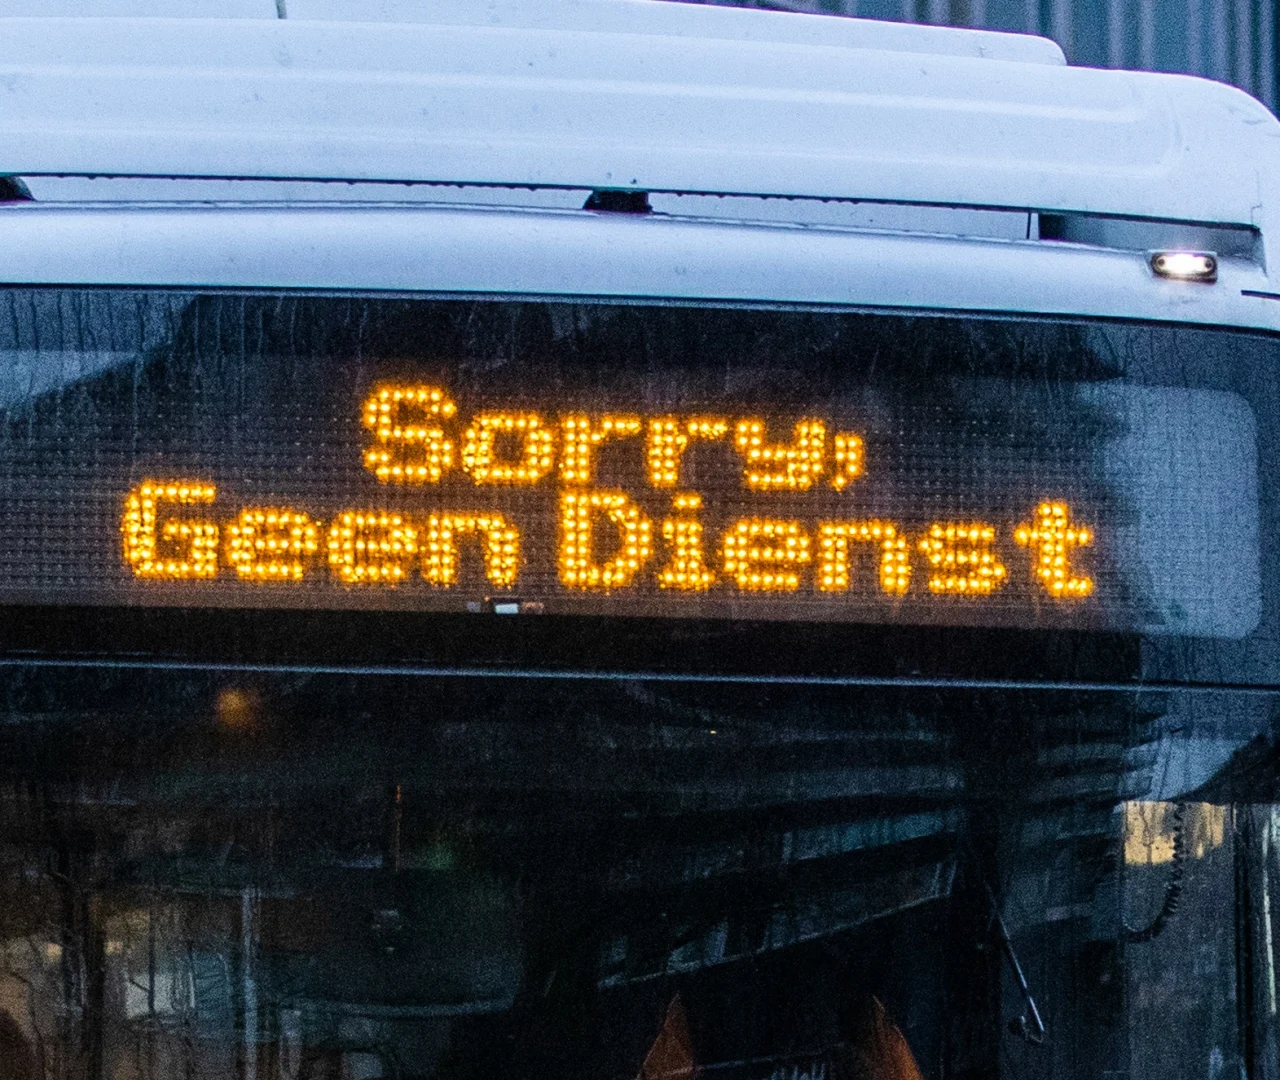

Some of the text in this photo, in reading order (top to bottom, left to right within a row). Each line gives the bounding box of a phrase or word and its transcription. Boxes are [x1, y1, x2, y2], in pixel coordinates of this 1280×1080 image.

[360, 380, 867, 492] Sorry,
[120, 477, 1095, 601] Geen Dienst
